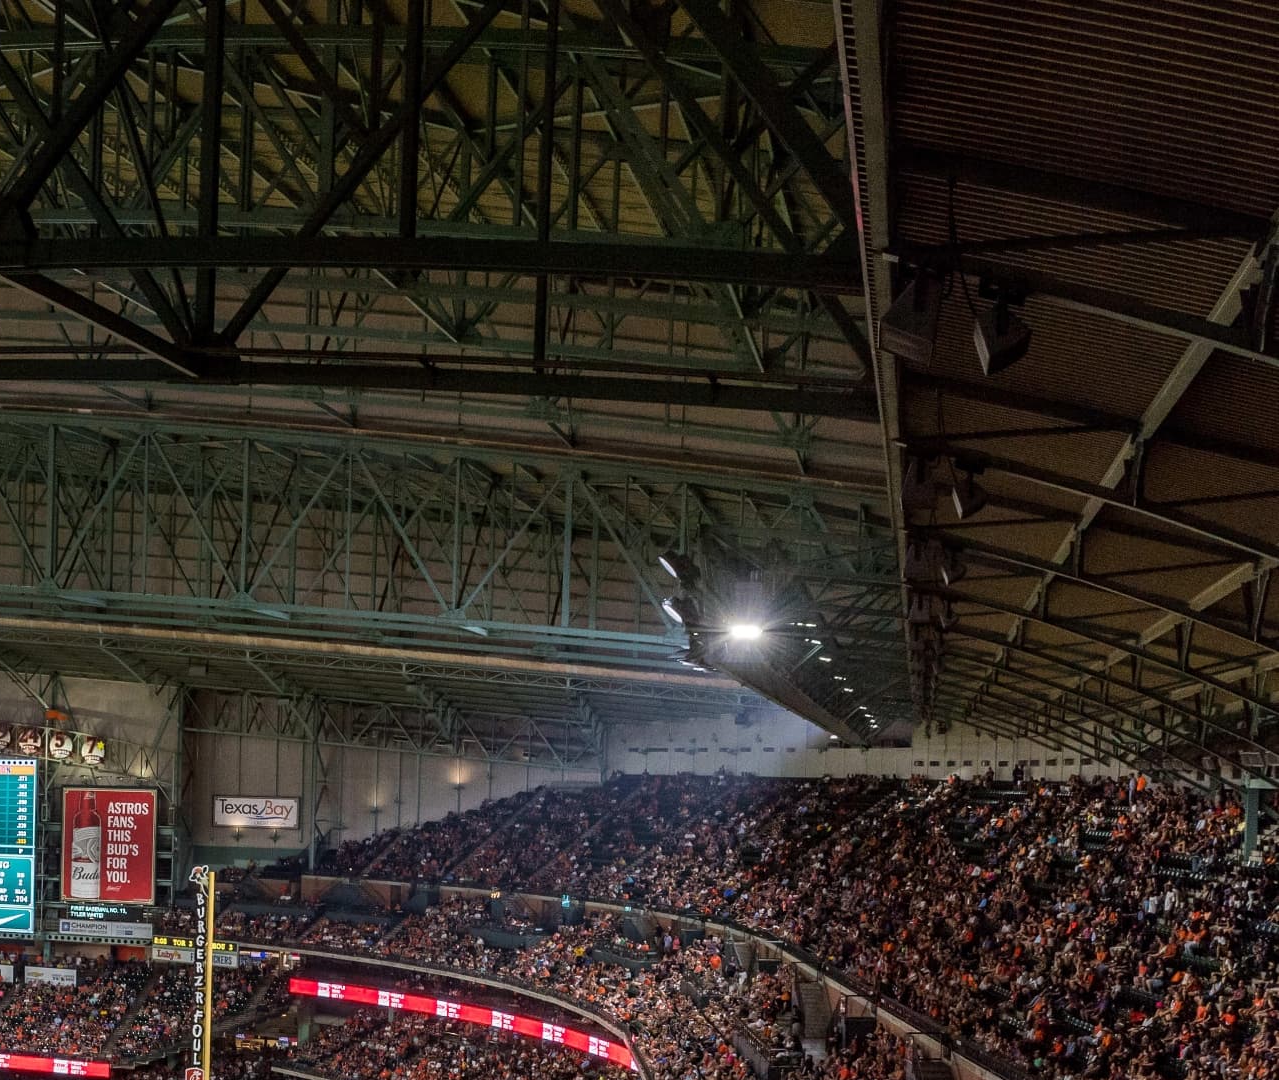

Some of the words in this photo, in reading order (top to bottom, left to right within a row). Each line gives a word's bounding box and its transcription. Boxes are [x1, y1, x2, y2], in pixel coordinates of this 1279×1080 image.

[107, 802, 149, 815] ASTROS
[219, 799, 259, 814] Texas
[265, 800, 293, 819] Bay
[107, 816, 137, 830] FANS,
[107, 830, 131, 842] THIS
[107, 844, 139, 856] BUD'S
[106, 857, 127, 869] FOR
[106, 871, 131, 883] YOU.
[70, 922, 108, 930] CHAMPION
[193, 1010, 203, 1067] FOUL
